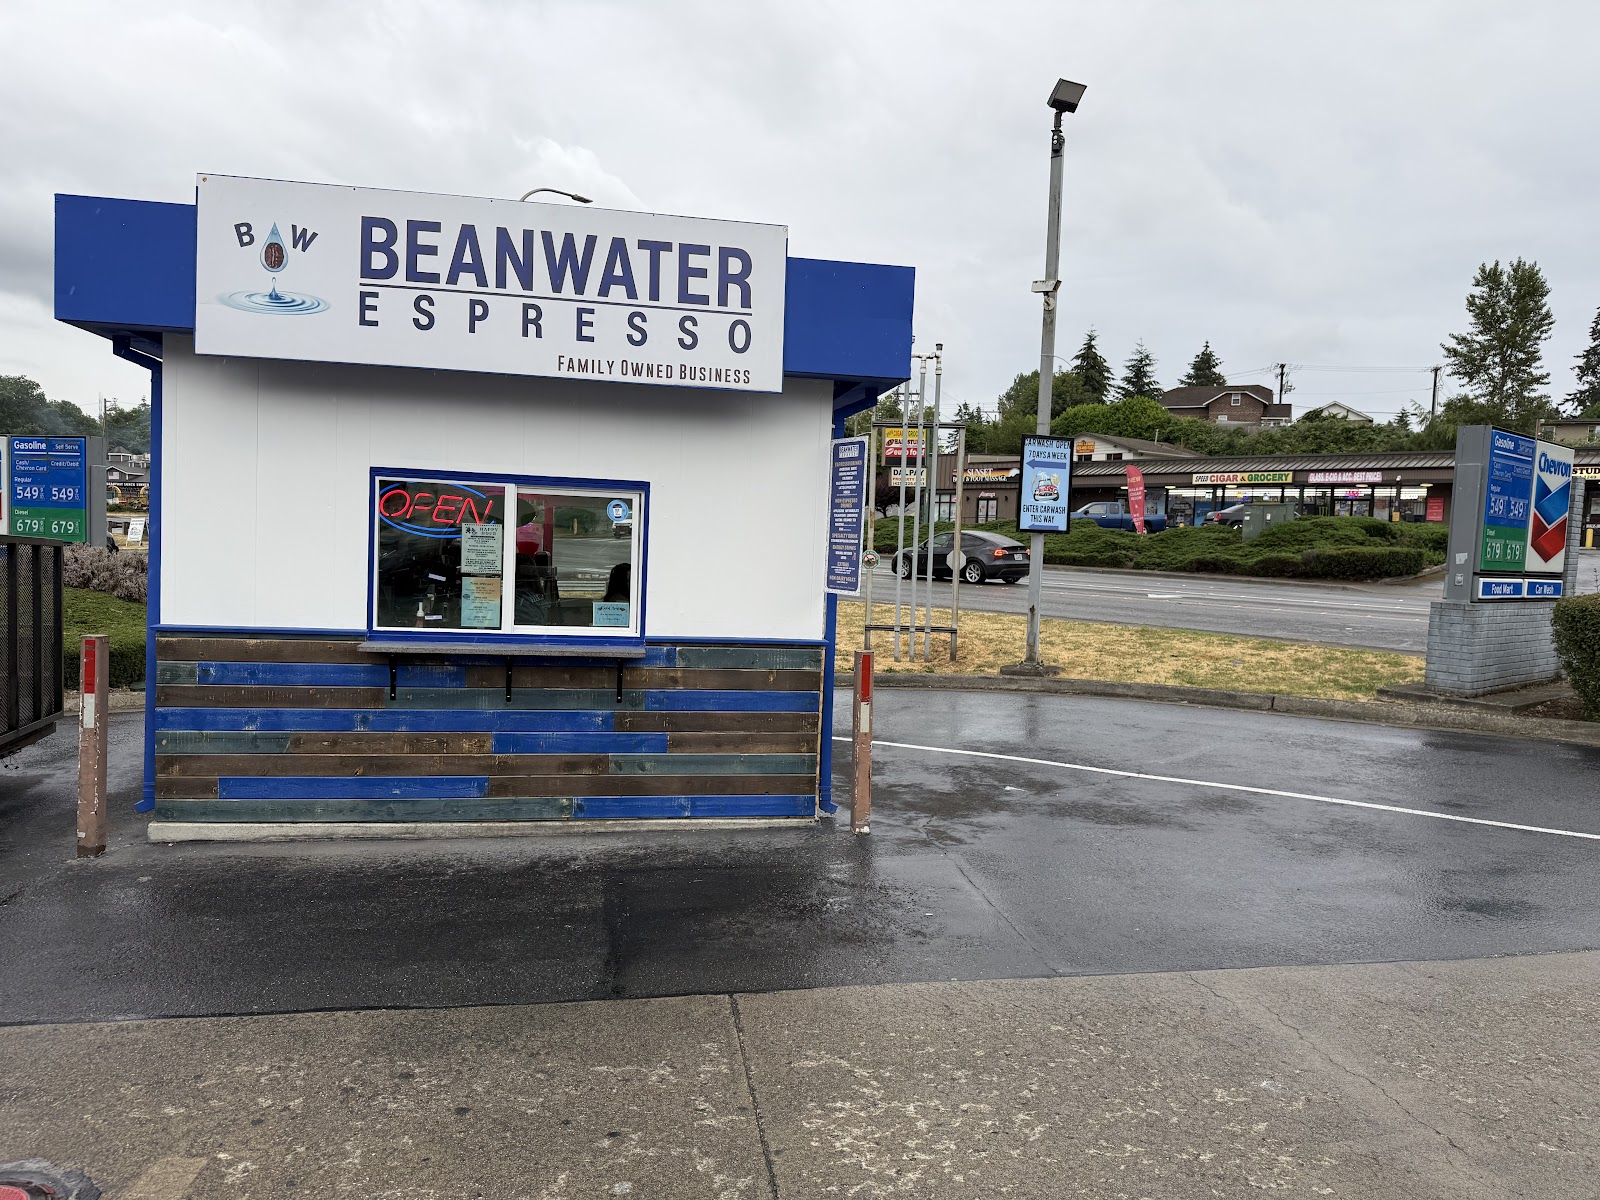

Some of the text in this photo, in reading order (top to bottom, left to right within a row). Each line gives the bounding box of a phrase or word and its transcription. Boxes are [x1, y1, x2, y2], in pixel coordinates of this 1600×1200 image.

[234, 222, 318, 252] B W
[359, 216, 752, 308] BEANWATER
[358, 291, 752, 354] ESPRESSO
[558, 355, 750, 384] FAMILY OWNED BUSINESS
[14, 440, 47, 450] Gasoline
[1494, 435, 1515, 450] Gasoline
[1052, 452, 1067, 460] WEEK
[1539, 451, 1572, 478] Chevron
[1247, 473, 1290, 482] GROCERY
[16, 486, 39, 499] 549
[52, 488, 74, 500] 549
[379, 490, 493, 525] OPEN
[1023, 504, 1039, 513] ENTER
[1043, 515, 1055, 523] WAY
[16, 519, 39, 532] 679
[51, 521, 74, 534] 679
[1492, 584, 1513, 594] Food Mart
[1544, 585, 1554, 594] Wash
